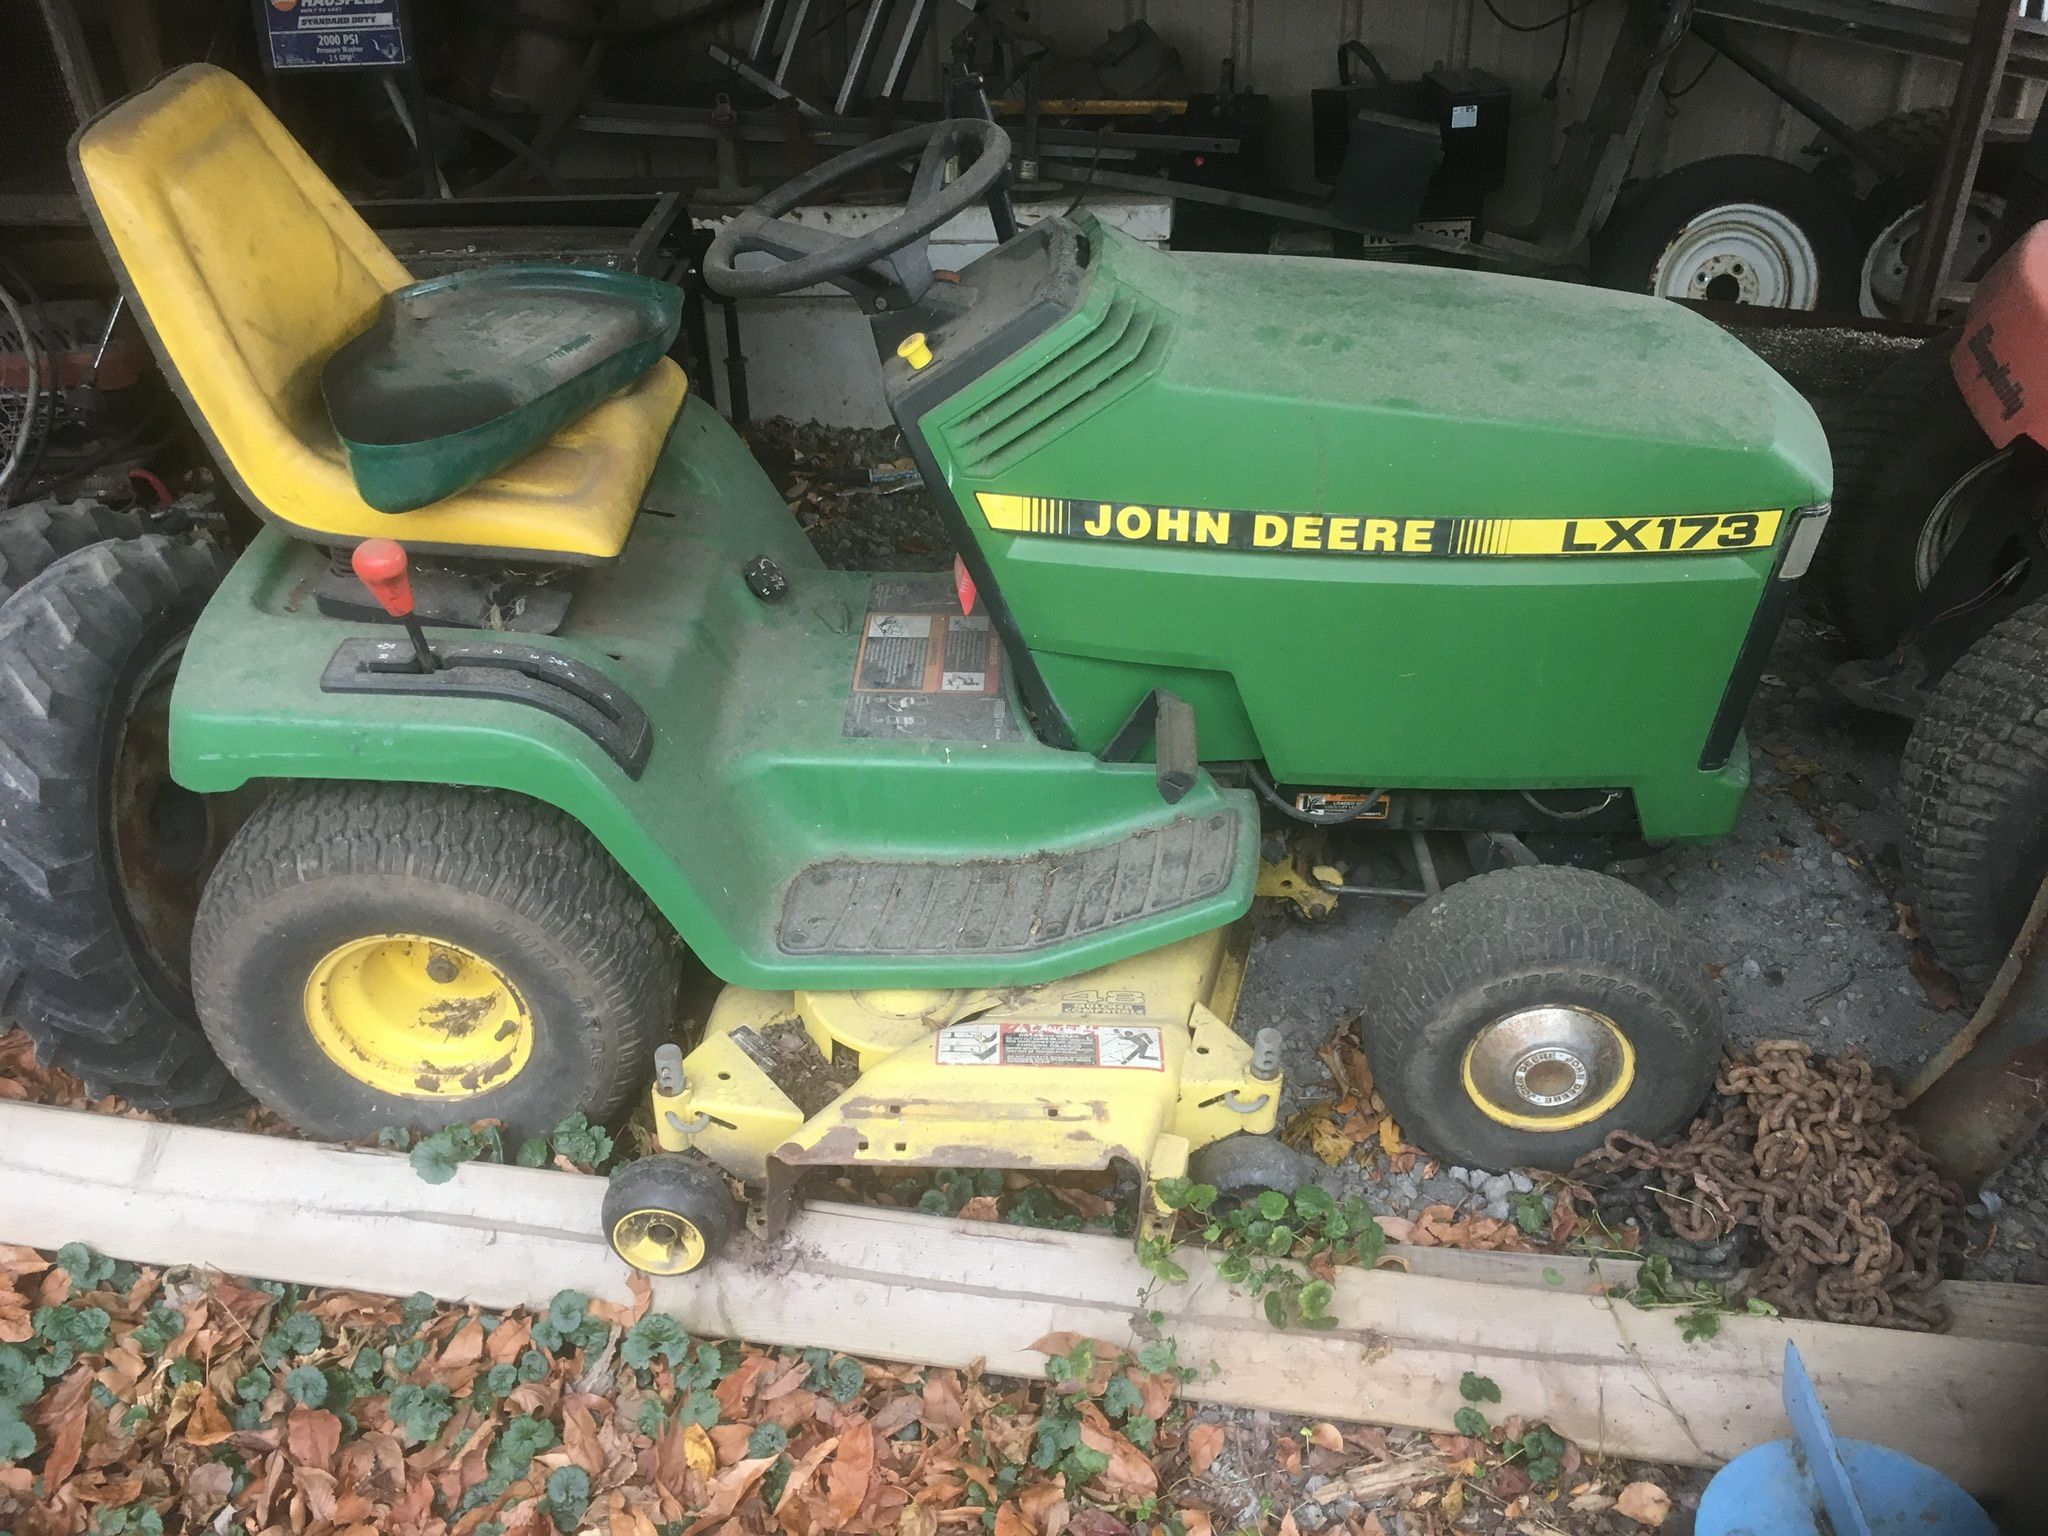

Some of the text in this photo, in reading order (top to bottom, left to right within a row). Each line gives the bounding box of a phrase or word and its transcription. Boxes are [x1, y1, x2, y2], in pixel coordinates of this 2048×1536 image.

[301, 16, 376, 26] STANDARD DUTY
[318, 33, 358, 46] 2000 PSI
[1084, 505, 1435, 553] JOHN DEERE
[1561, 514, 1759, 552] LX173
[1062, 990, 1146, 1004] 48
